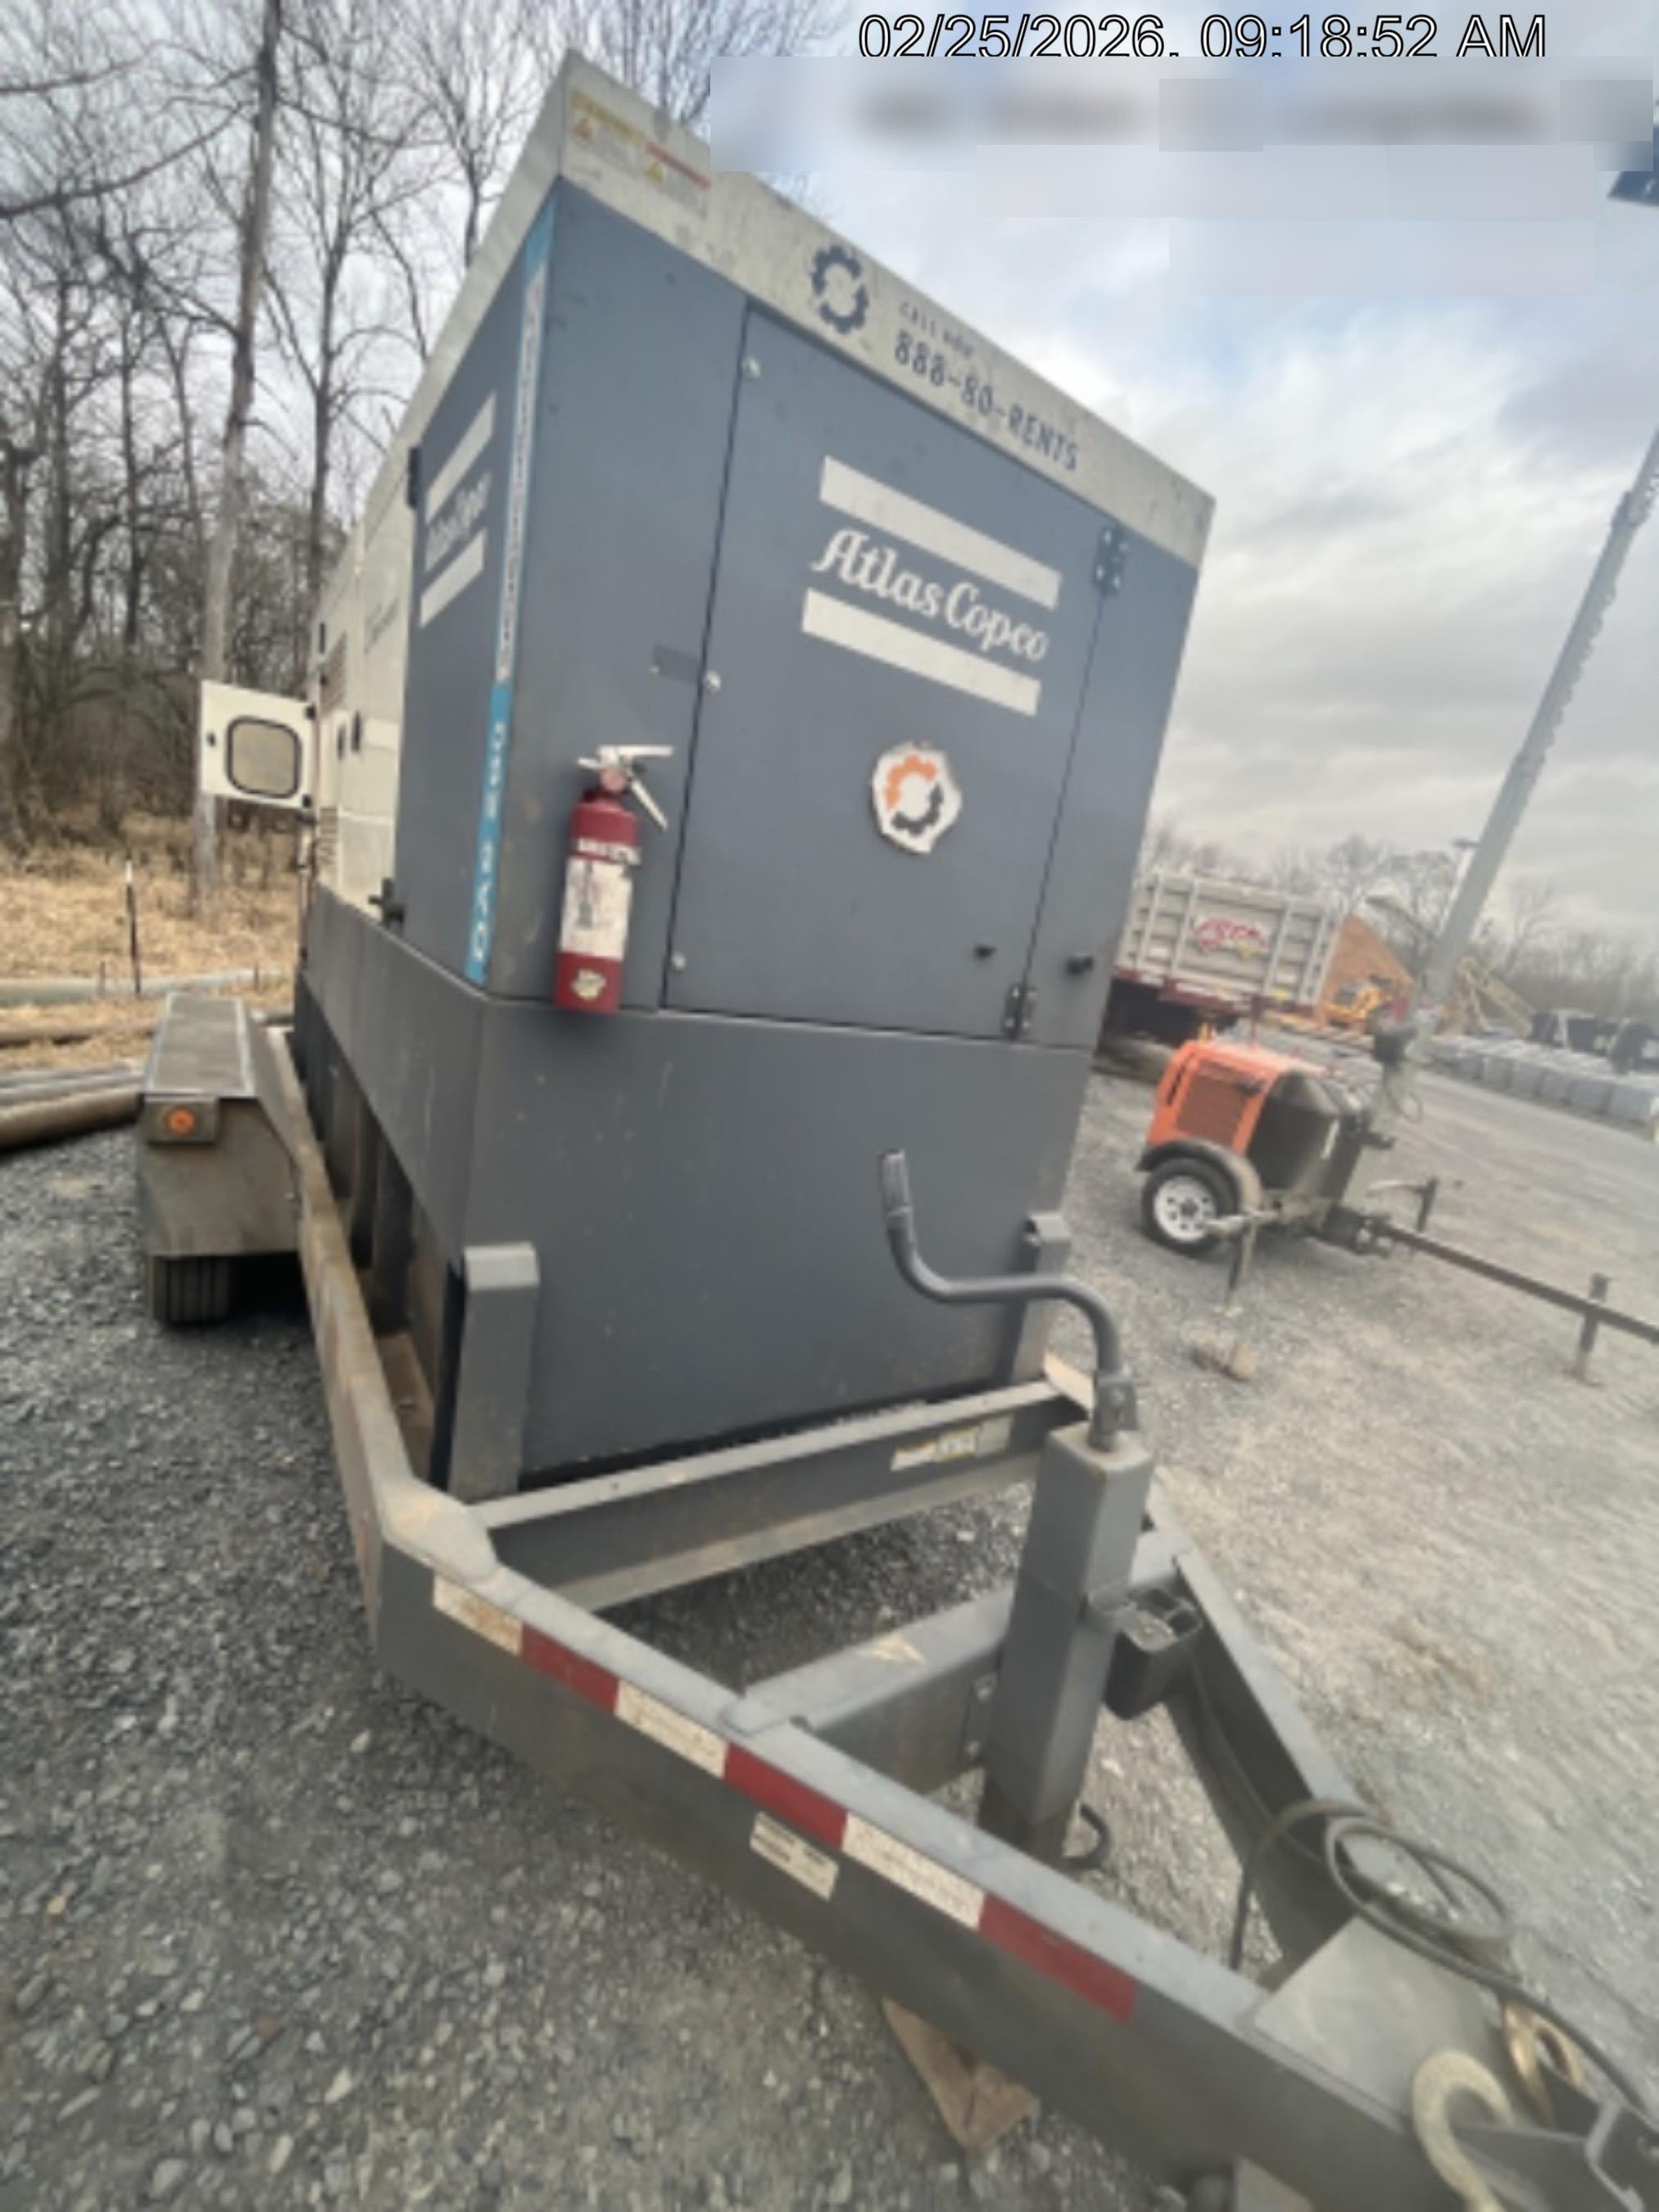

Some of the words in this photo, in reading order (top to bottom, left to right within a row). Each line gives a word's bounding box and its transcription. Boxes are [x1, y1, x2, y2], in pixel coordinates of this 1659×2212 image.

[895, 329, 1078, 471] 888-80-RENTS
[810, 528, 945, 619] Atlas
[945, 581, 1049, 662] Copco
